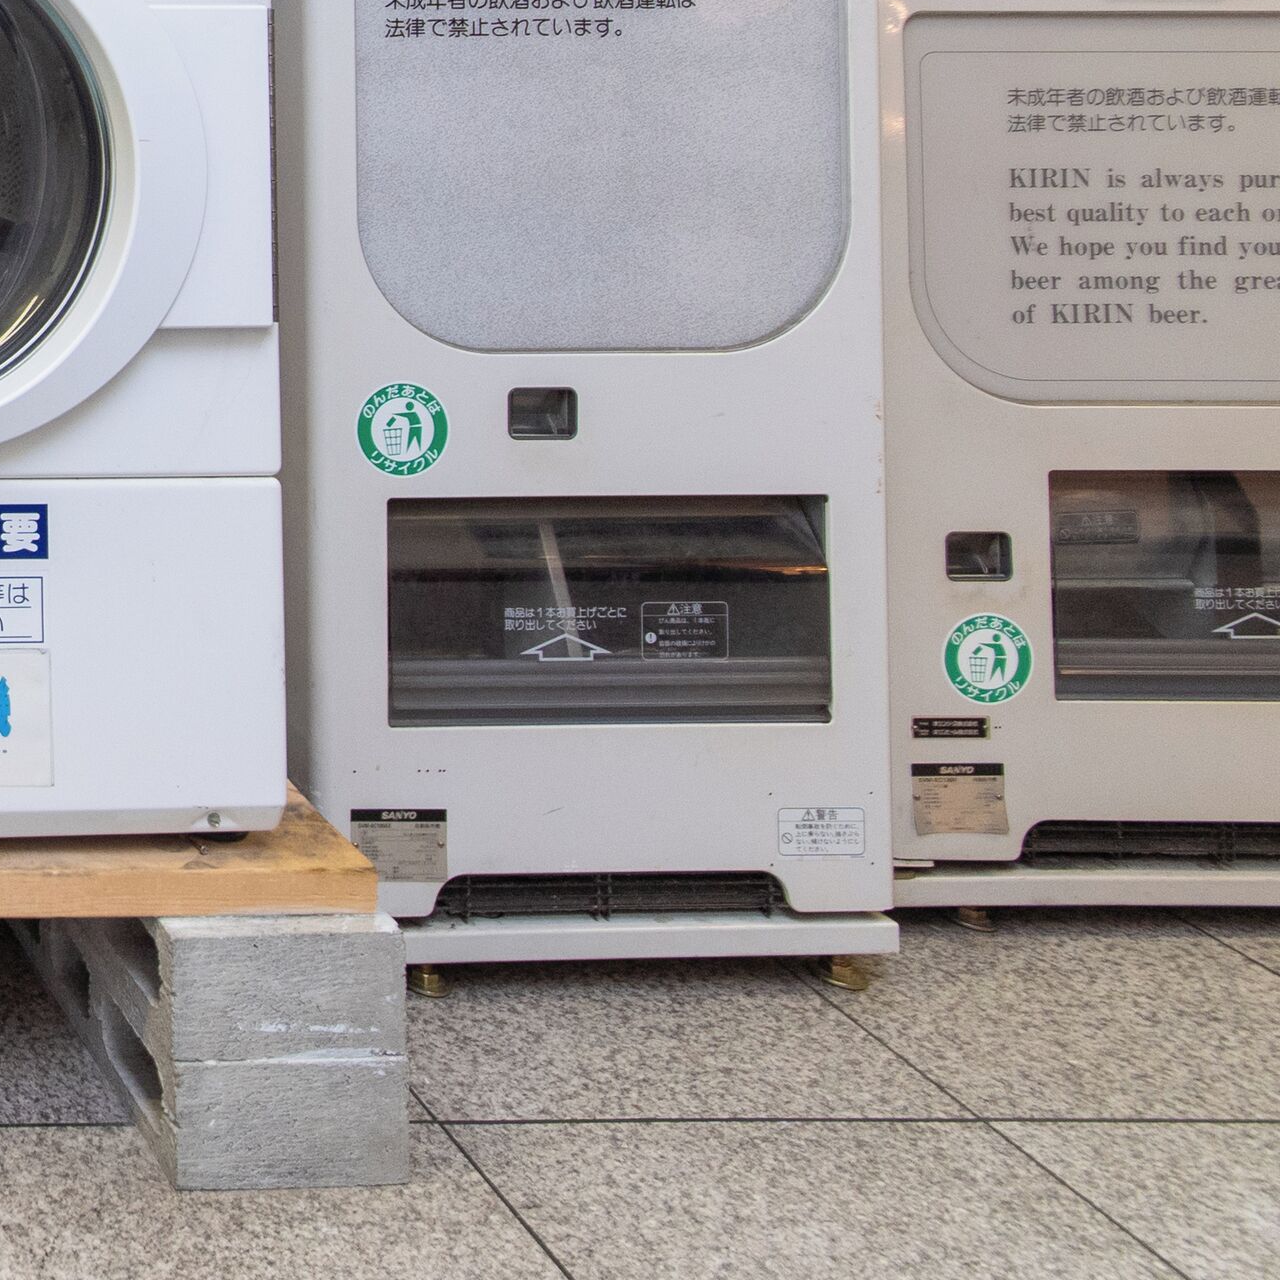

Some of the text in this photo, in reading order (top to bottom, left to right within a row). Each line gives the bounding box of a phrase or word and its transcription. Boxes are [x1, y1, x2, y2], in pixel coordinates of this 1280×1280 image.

[385, 17, 625, 39] 法律で禁止されています。
[1007, 113, 1237, 133] 法律で禁止されています。
[1008, 168, 1091, 190] KIRIN
[1107, 168, 1127, 190] is
[1140, 169, 1225, 193] always
[1008, 202, 1056, 223] best
[1066, 202, 1149, 227] quality
[1160, 205, 1184, 223] to
[1195, 202, 1251, 223] each
[1010, 235, 1048, 257] We
[1060, 235, 1115, 259] hope
[1126, 240, 1168, 260] you
[1178, 234, 1228, 257] find
[1010, 269, 1061, 291] beer
[1078, 273, 1161, 294] among
[1177, 270, 1218, 291] the
[1012, 302, 1208, 324] of KIRIN beer.
[363, 385, 441, 418] のんだあとは
[370, 449, 438, 474] リサイクル
[504, 619, 597, 630] 取り出してください
[951, 617, 1028, 648] のんだあとは
[954, 676, 1021, 701] リサイクル
[382, 811, 417, 819] SANYO
